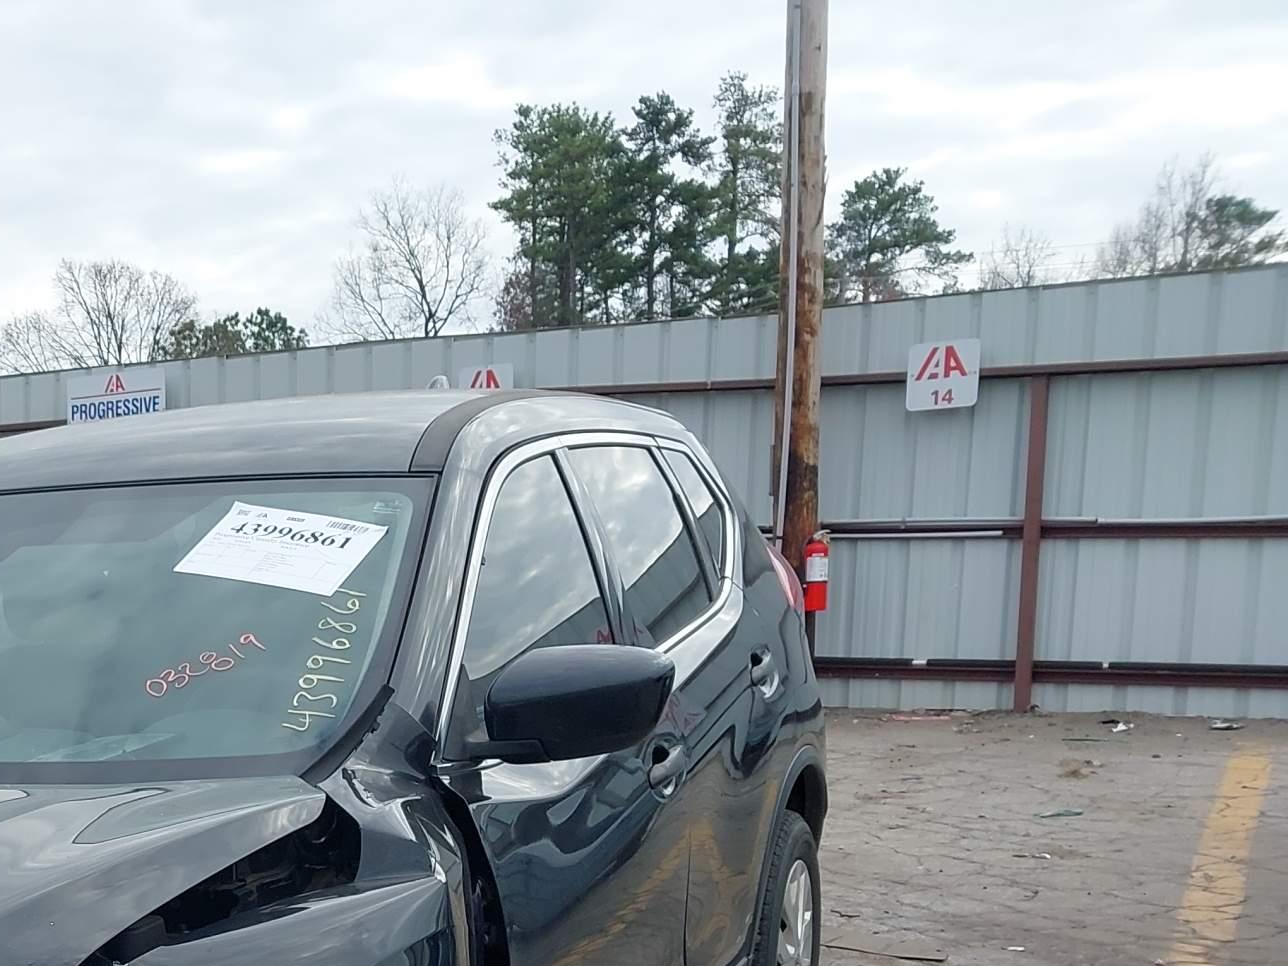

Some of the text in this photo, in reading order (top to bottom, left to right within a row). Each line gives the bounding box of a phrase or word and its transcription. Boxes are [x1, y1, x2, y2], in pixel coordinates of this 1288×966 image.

[71, 395, 160, 421] PROGRESSIVE
[930, 388, 954, 405] 14
[230, 521, 353, 549] 43996861
[281, 587, 368, 732] 43996861
